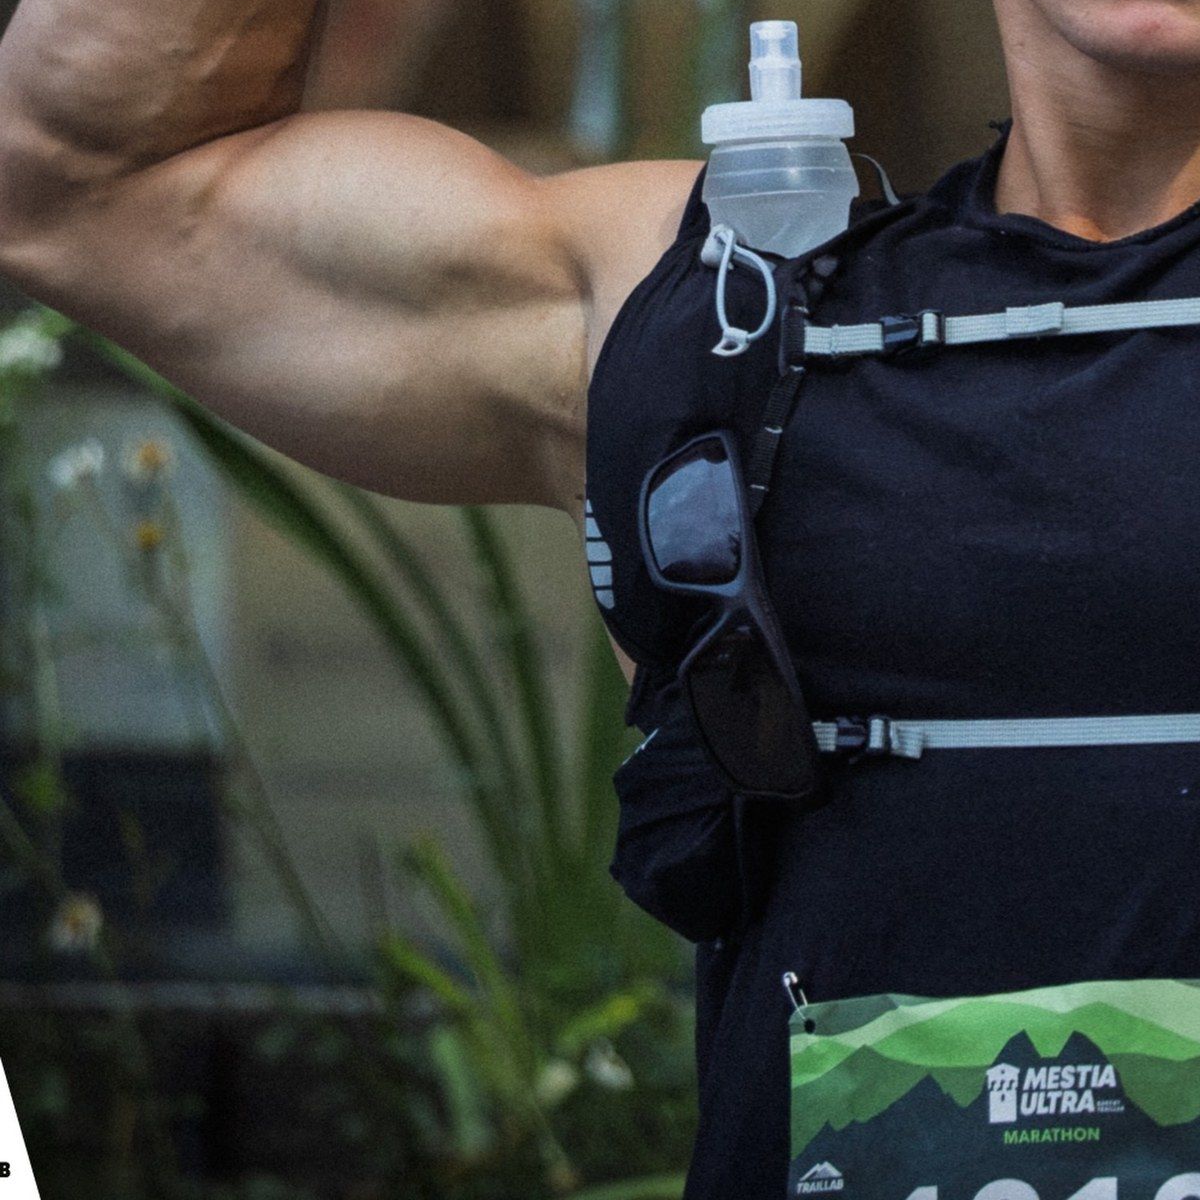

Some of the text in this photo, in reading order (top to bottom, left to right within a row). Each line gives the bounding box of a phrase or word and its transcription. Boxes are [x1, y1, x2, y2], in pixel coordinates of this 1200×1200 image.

[1022, 1064, 1117, 1091] MESTIA
[1020, 1089, 1096, 1116] ULTRA
[1003, 1127, 1100, 1145] MARATHON
[797, 1178, 844, 1194] TRAILLAB
